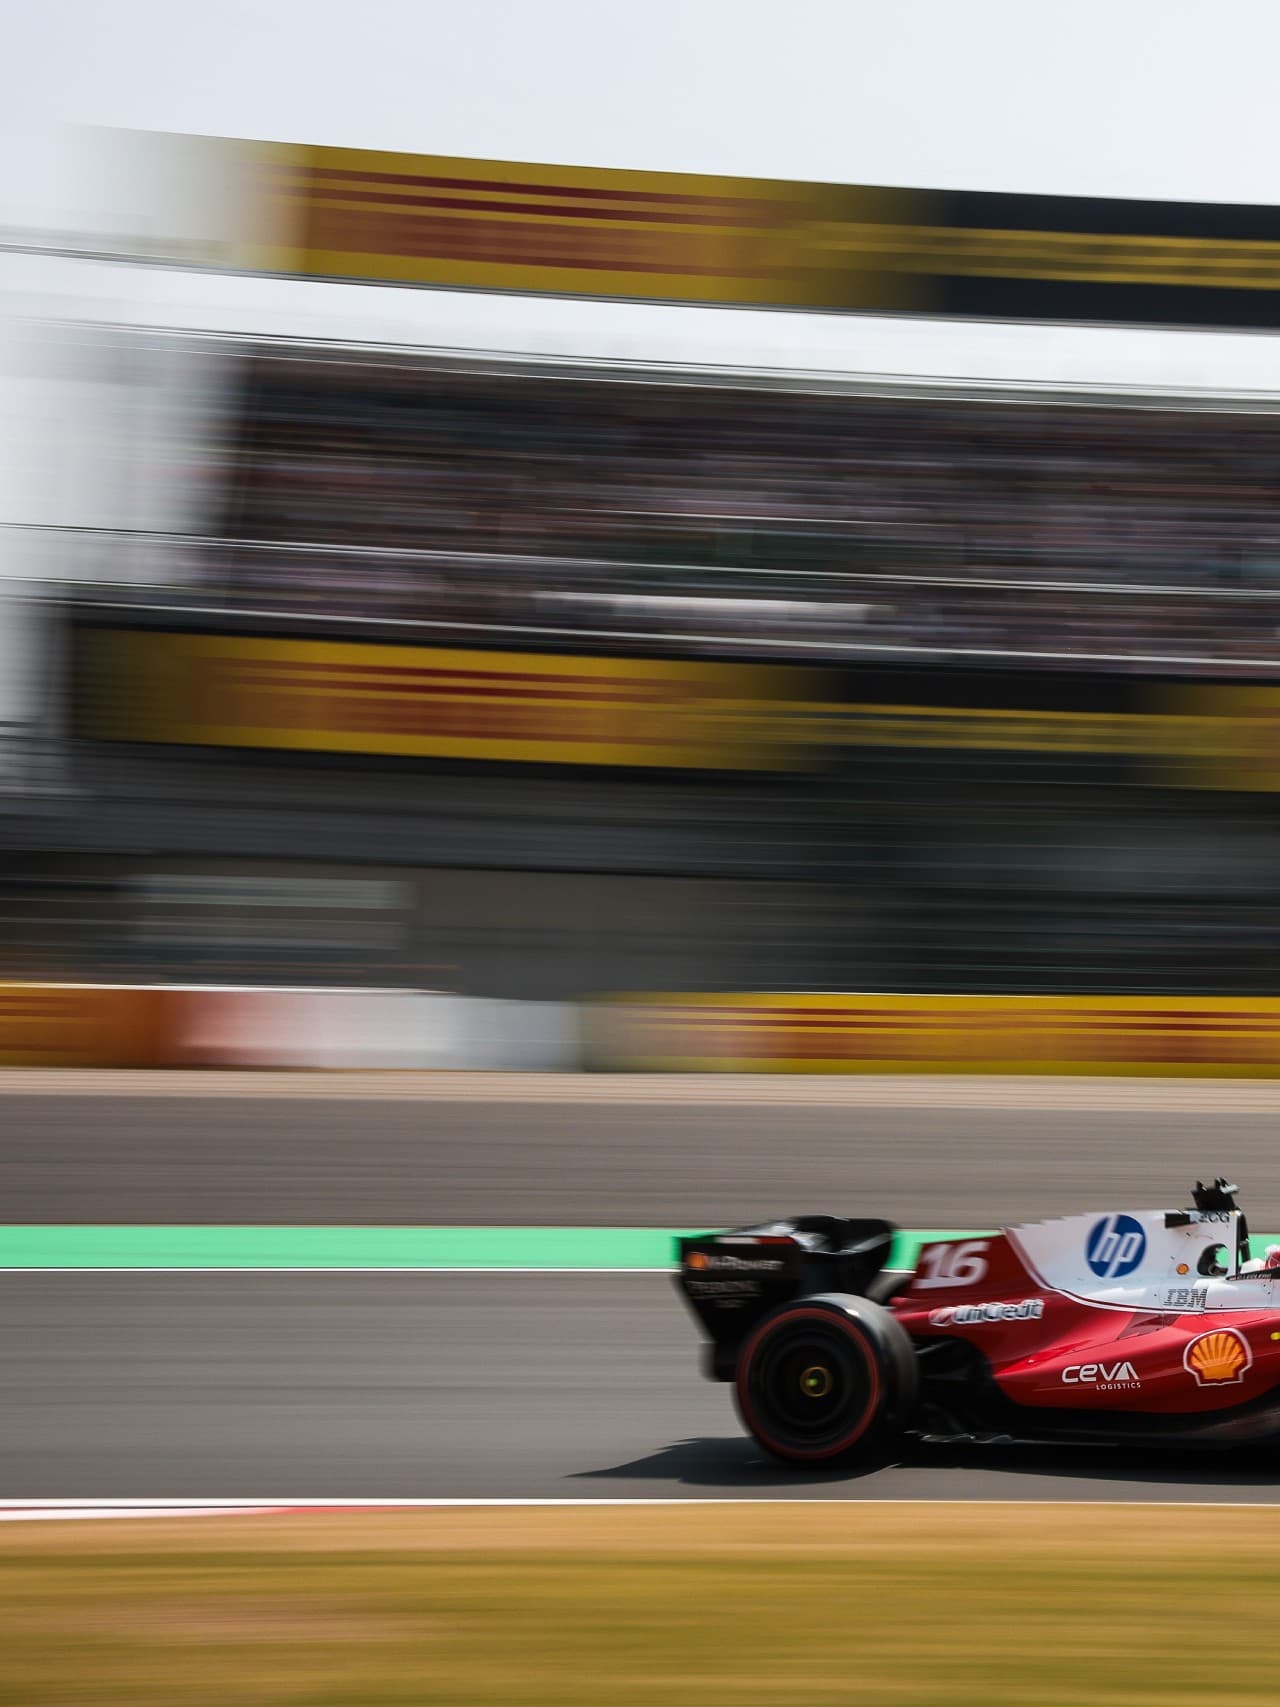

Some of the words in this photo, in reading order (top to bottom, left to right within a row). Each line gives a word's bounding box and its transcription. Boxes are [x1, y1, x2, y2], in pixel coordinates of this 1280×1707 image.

[1090, 1214, 1144, 1278] hp
[911, 1241, 992, 1289] 16
[1163, 1288, 1208, 1308] IBM
[1096, 1382, 1141, 1391] LOGISTICS
